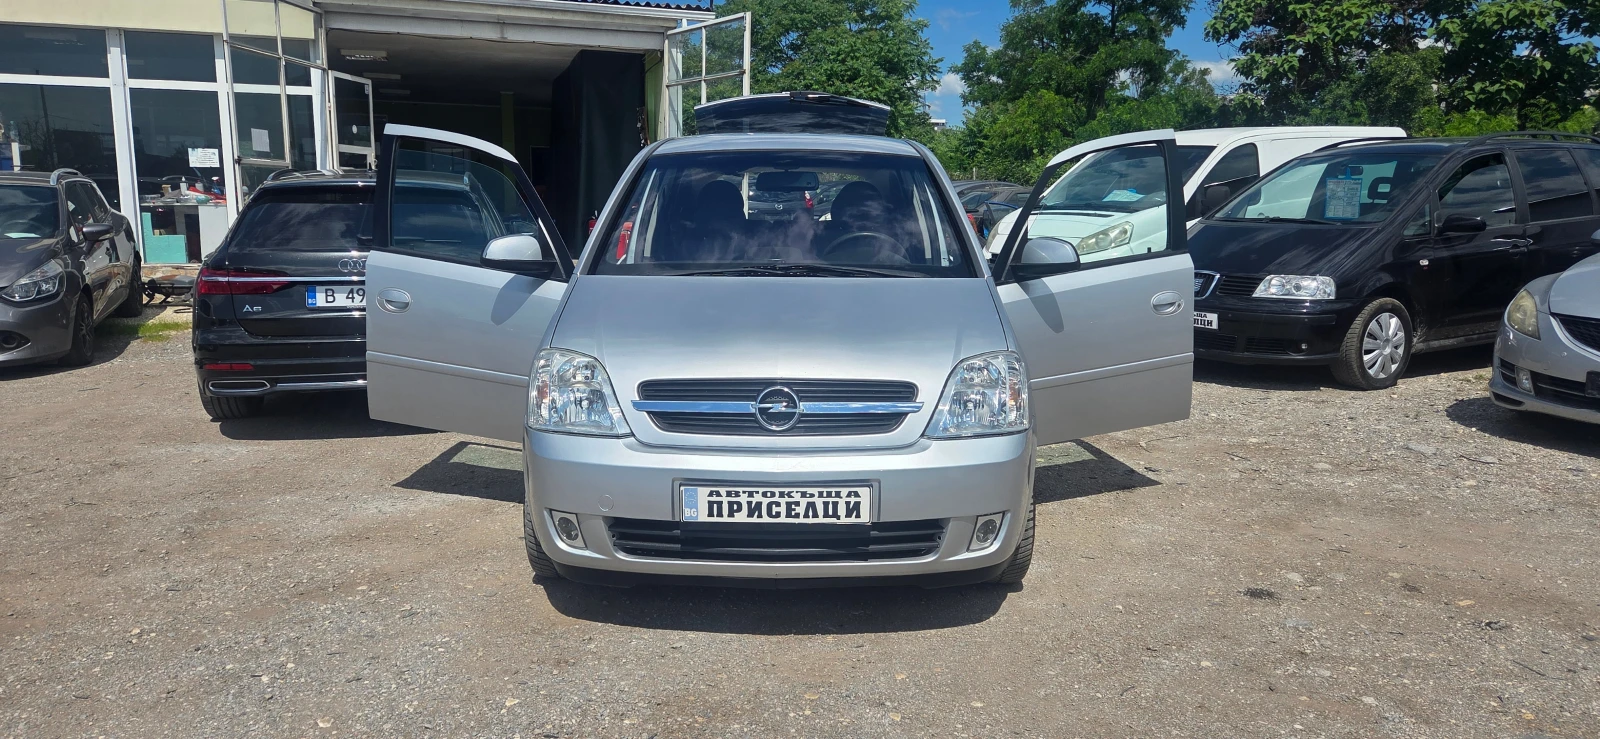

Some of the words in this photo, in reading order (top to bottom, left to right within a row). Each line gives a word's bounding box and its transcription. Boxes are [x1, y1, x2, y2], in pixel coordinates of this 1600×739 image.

[325, 288, 336, 303] B
[243, 304, 262, 312] A6
[707, 490, 861, 499] АВТОКЪЩА
[684, 508, 698, 517] BG
[707, 500, 861, 520] ПРИСЕЛЦИ
